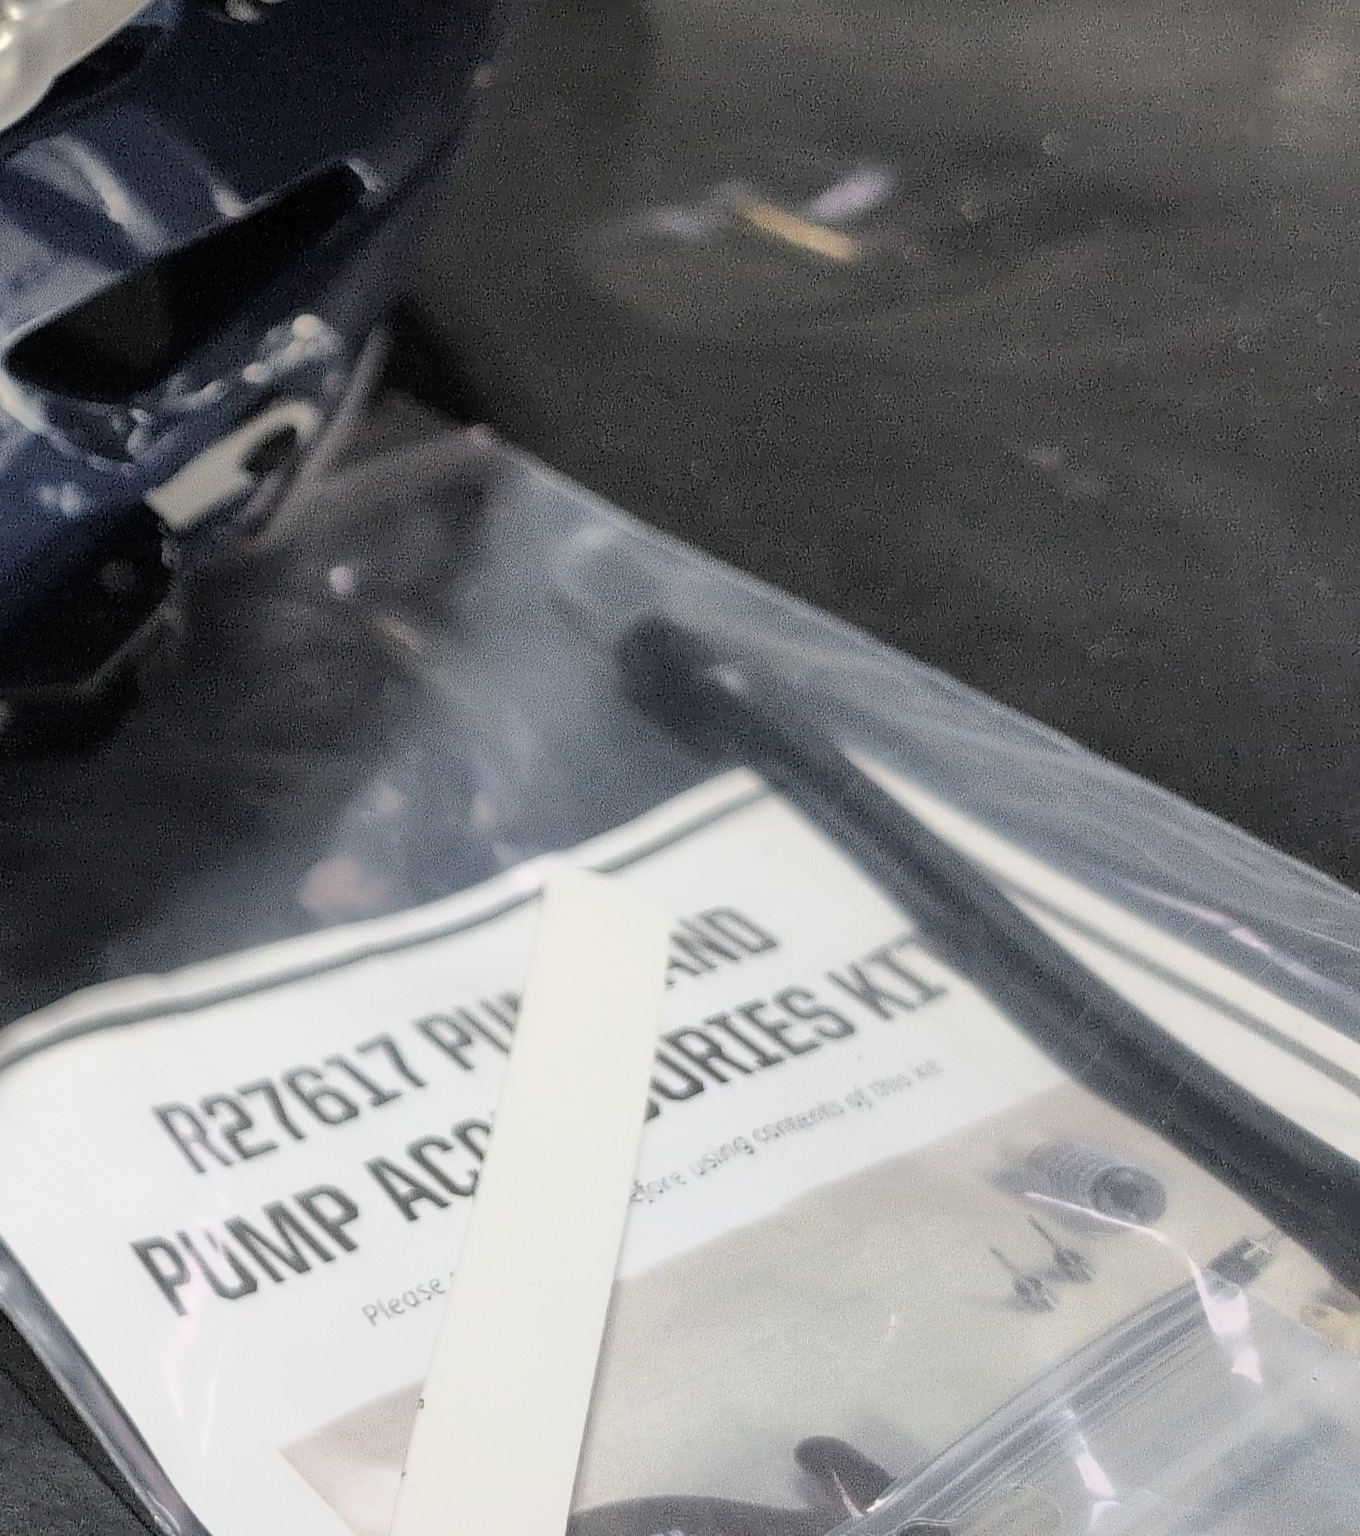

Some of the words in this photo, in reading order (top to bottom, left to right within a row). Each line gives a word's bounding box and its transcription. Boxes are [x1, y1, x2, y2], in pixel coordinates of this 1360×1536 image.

[151, 1032, 427, 1174] R27617
[129, 1183, 359, 1317] PUMP
[361, 1277, 447, 1327] Please
